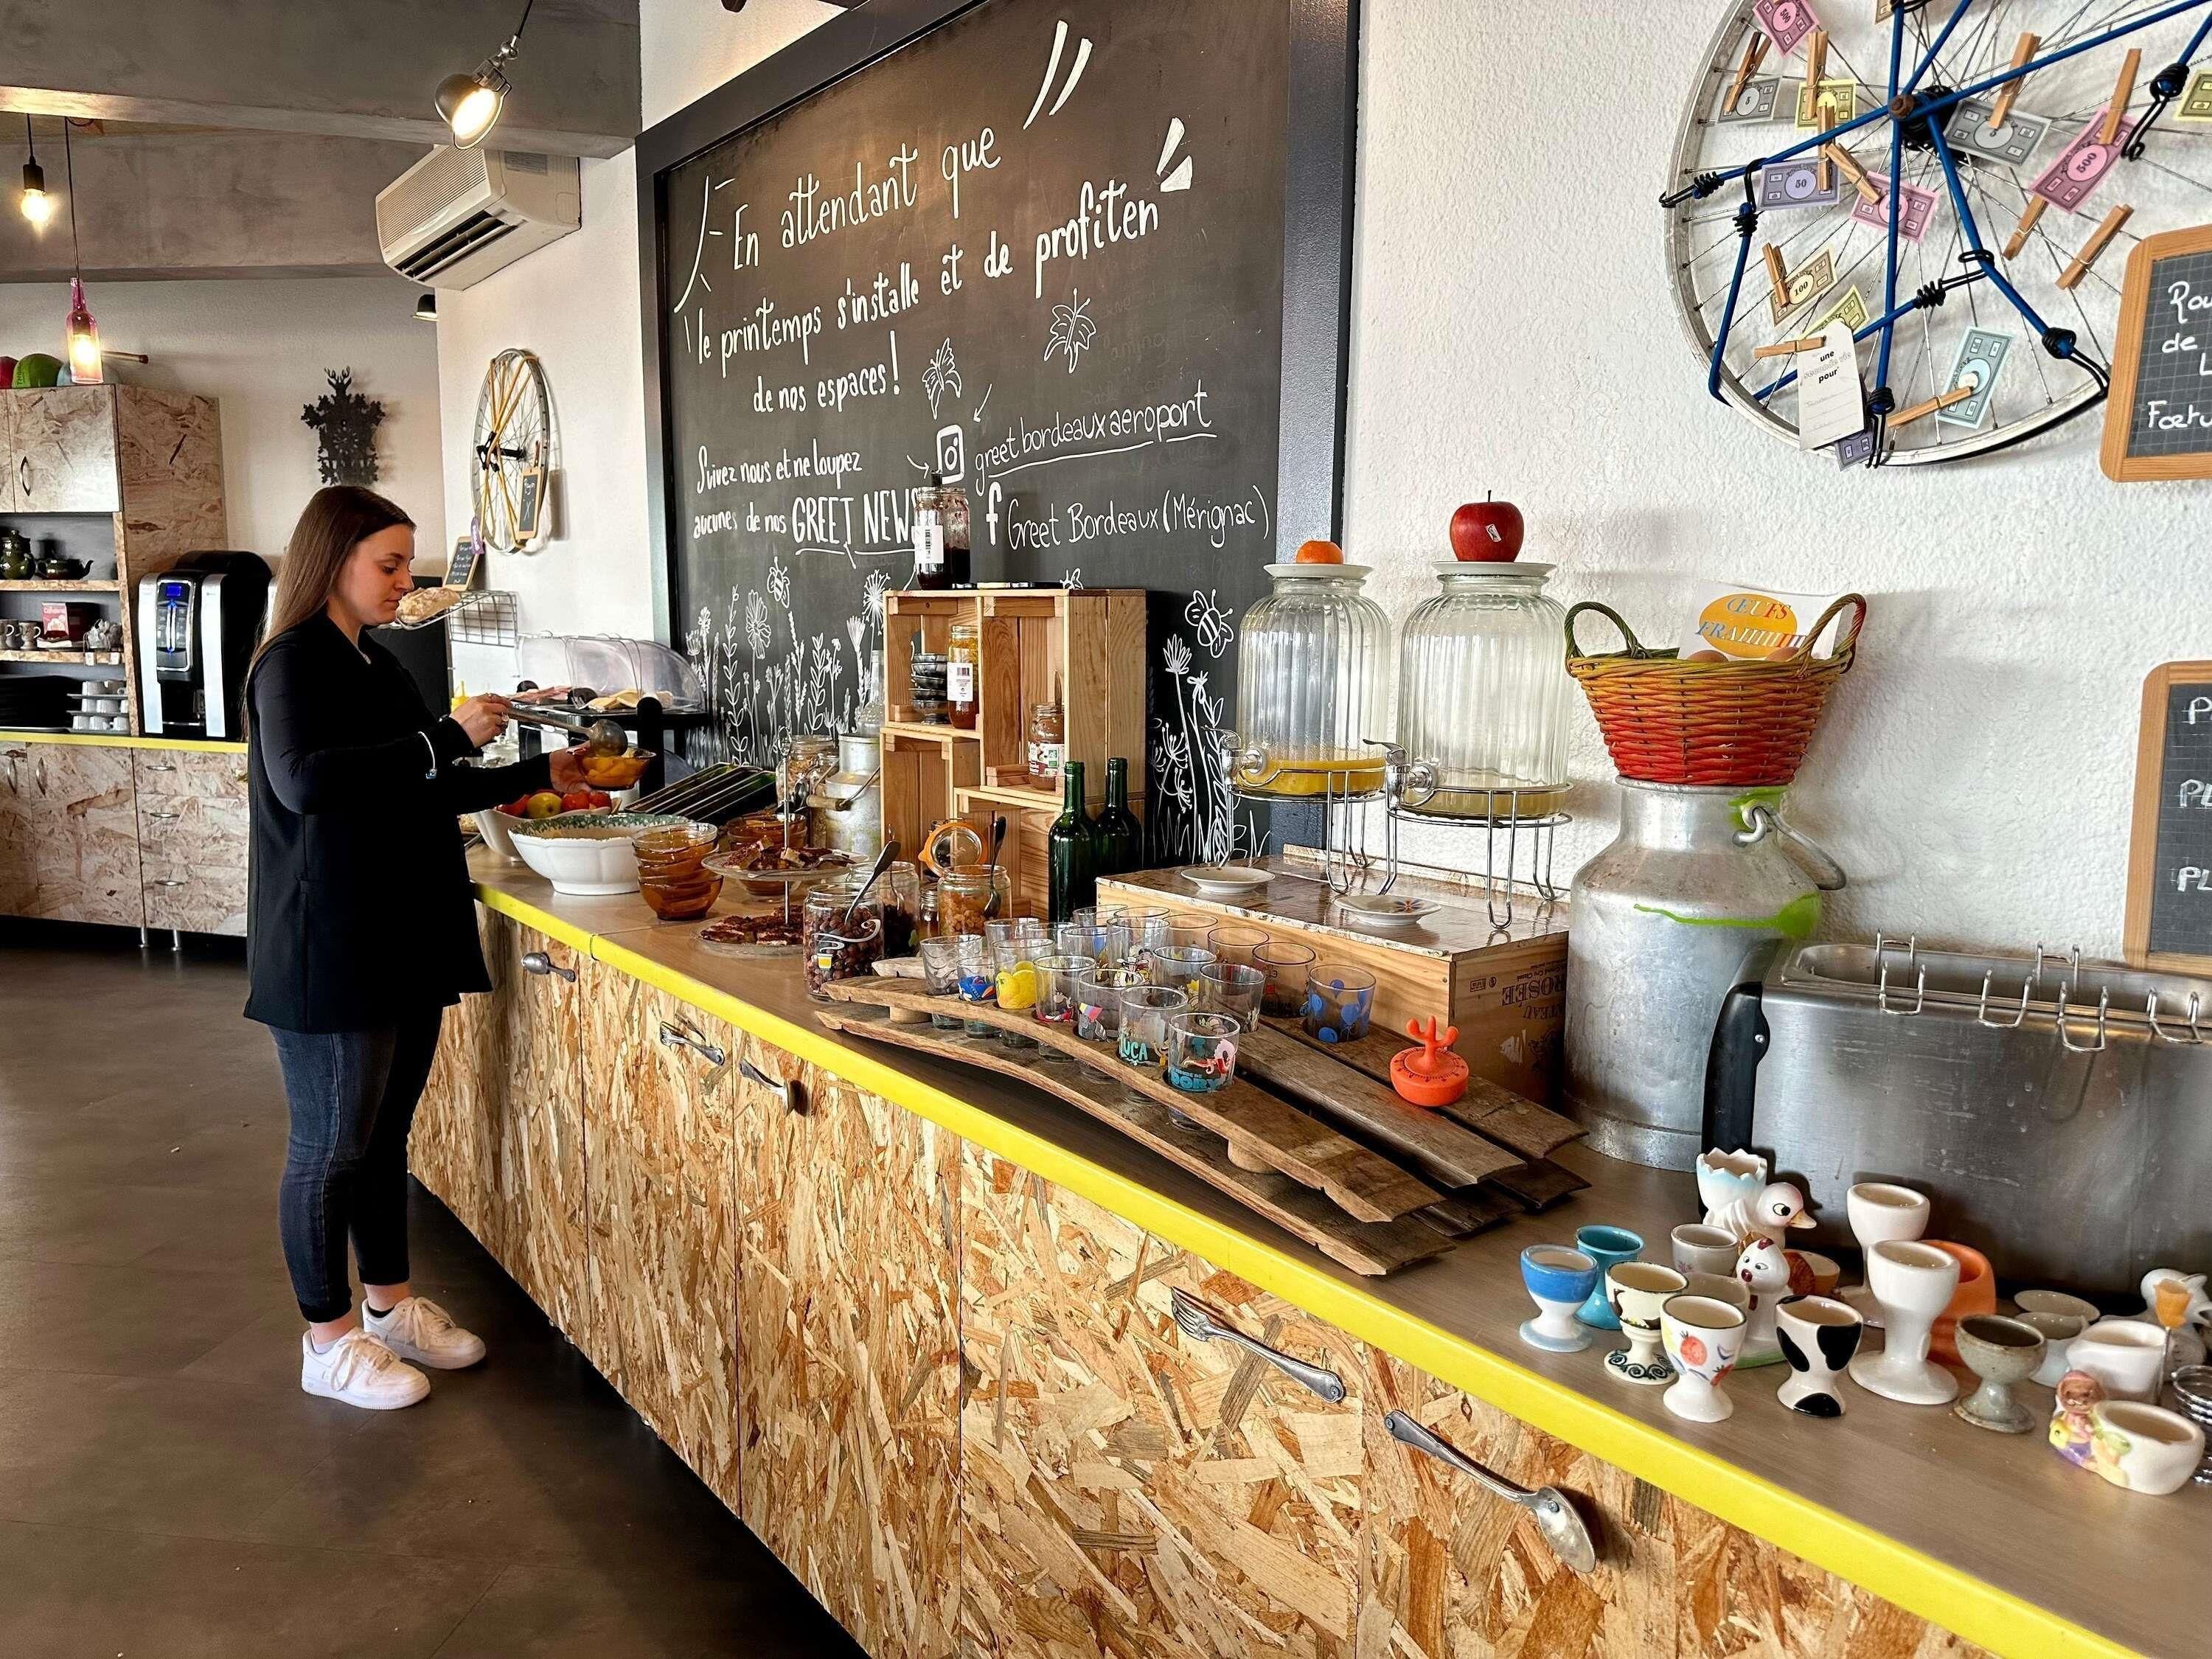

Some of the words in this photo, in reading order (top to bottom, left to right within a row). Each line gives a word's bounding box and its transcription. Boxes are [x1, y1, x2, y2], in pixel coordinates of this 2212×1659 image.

[2076, 152, 2097, 174] 500
[734, 204, 759, 271] En
[780, 142, 919, 248] attendant
[942, 127, 1001, 219] que
[1795, 178, 1806, 189] 50
[698, 307, 712, 365] le
[721, 296, 821, 379] printemps
[837, 262, 919, 330] s'installe
[941, 243, 964, 296] et
[984, 230, 1014, 278] de
[1793, 280, 1809, 297] 100
[1820, 350, 1834, 362] une
[2161, 332, 2198, 354] de
[753, 375, 774, 413] de
[778, 386, 807, 412] nos
[696, 445, 738, 494] Suivez
[740, 461, 772, 484] nous
[776, 448, 792, 480] et
[793, 456, 811, 478] ne
[813, 438, 863, 490] loupez
[692, 510, 738, 539] aucunes
[745, 501, 761, 533] de
[764, 515, 787, 534] nos
[792, 496, 855, 545] GREET
[1009, 498, 1061, 550] Greet
[1067, 500, 1159, 543] Bordeaux
[1163, 484, 1269, 549] (Mérignac)
[2188, 696, 2212, 725] P
